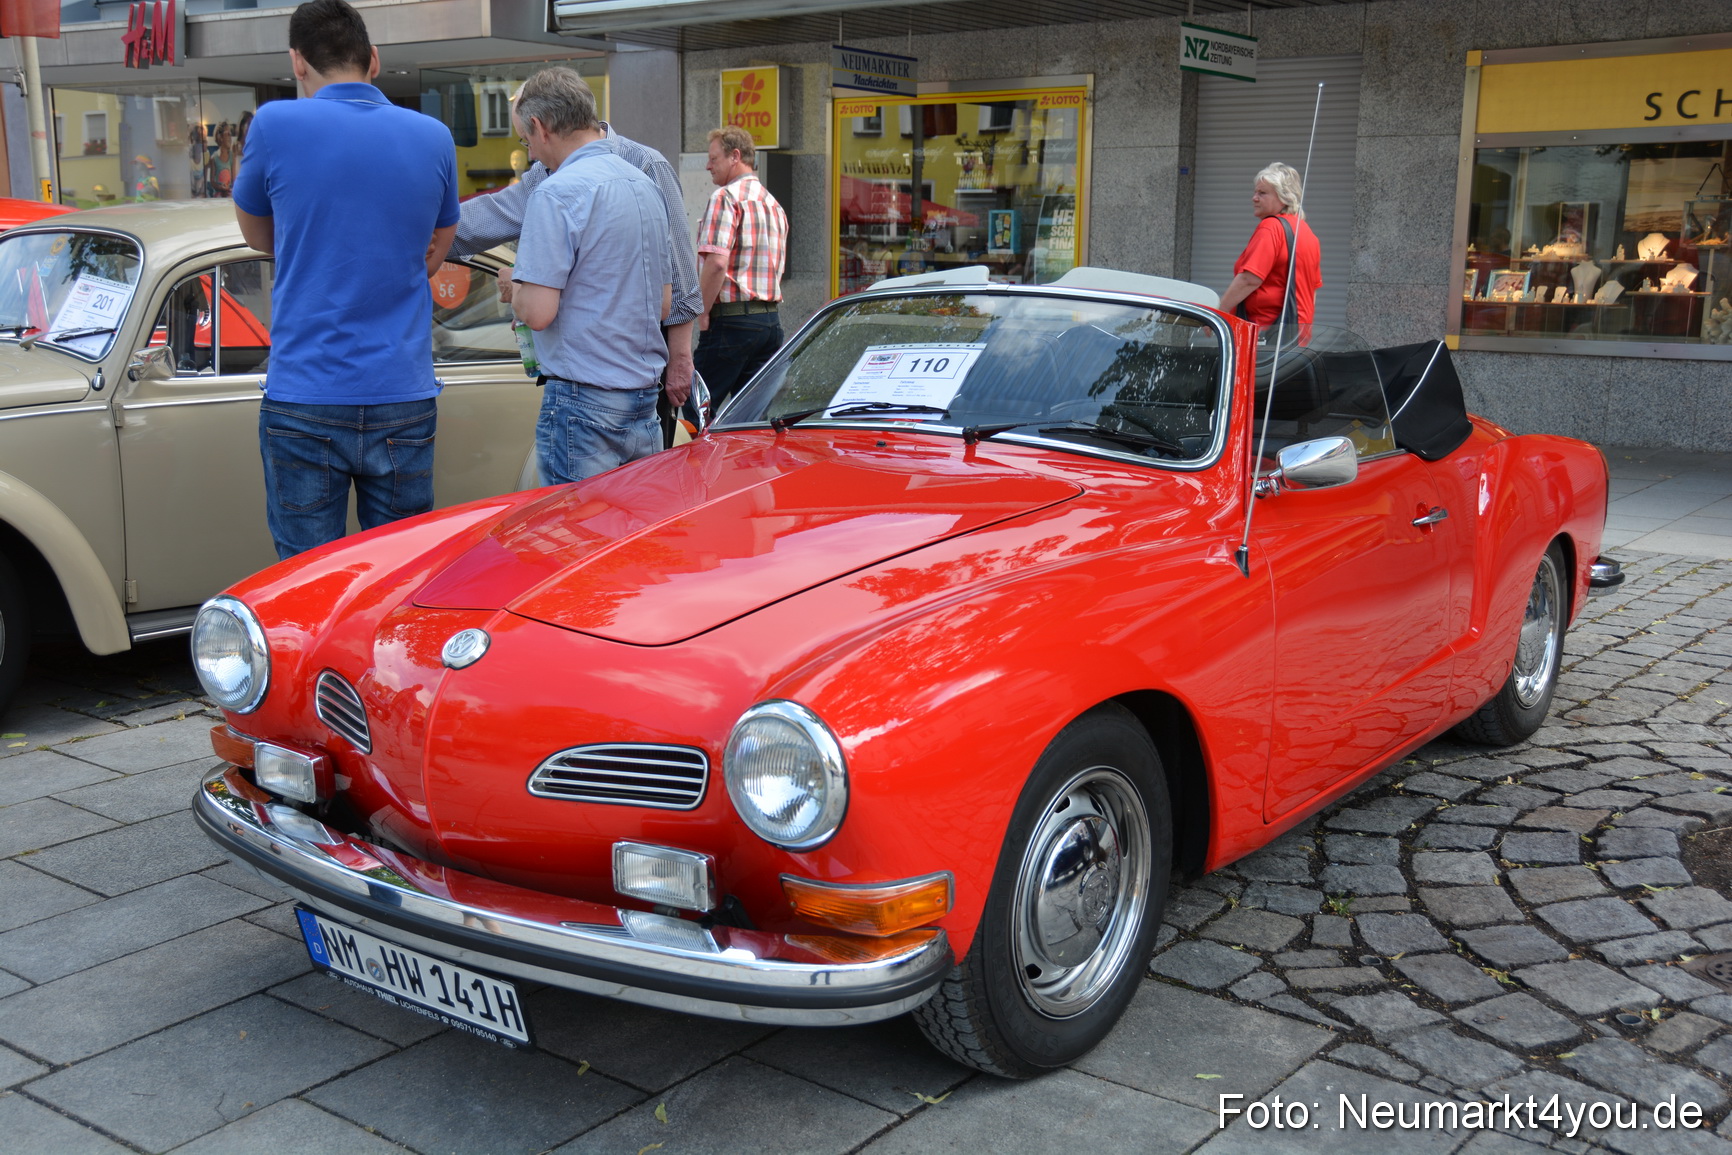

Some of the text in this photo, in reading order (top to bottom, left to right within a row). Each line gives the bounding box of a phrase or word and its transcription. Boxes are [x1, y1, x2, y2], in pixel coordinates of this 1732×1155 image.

[1184, 35, 1210, 62] NZ
[1210, 40, 1254, 59] NORDBAYERISCHE
[841, 53, 910, 79] NEUMARKTER
[1209, 52, 1232, 66] ZEITUNG
[853, 73, 898, 91] Nachrichten
[849, 104, 875, 114] LOTTO
[1051, 95, 1080, 105] LOTTO
[1644, 88, 1732, 121] SCH
[727, 111, 772, 128] LOTTO
[92, 293, 115, 312] 201
[909, 357, 950, 373] 110
[313, 941, 322, 954] D
[318, 922, 524, 1033] NM HW 141H
[343, 977, 375, 995] AUTOHAUS
[375, 988, 400, 1006] THIEL
[400, 999, 440, 1021] LICHTENFELS
